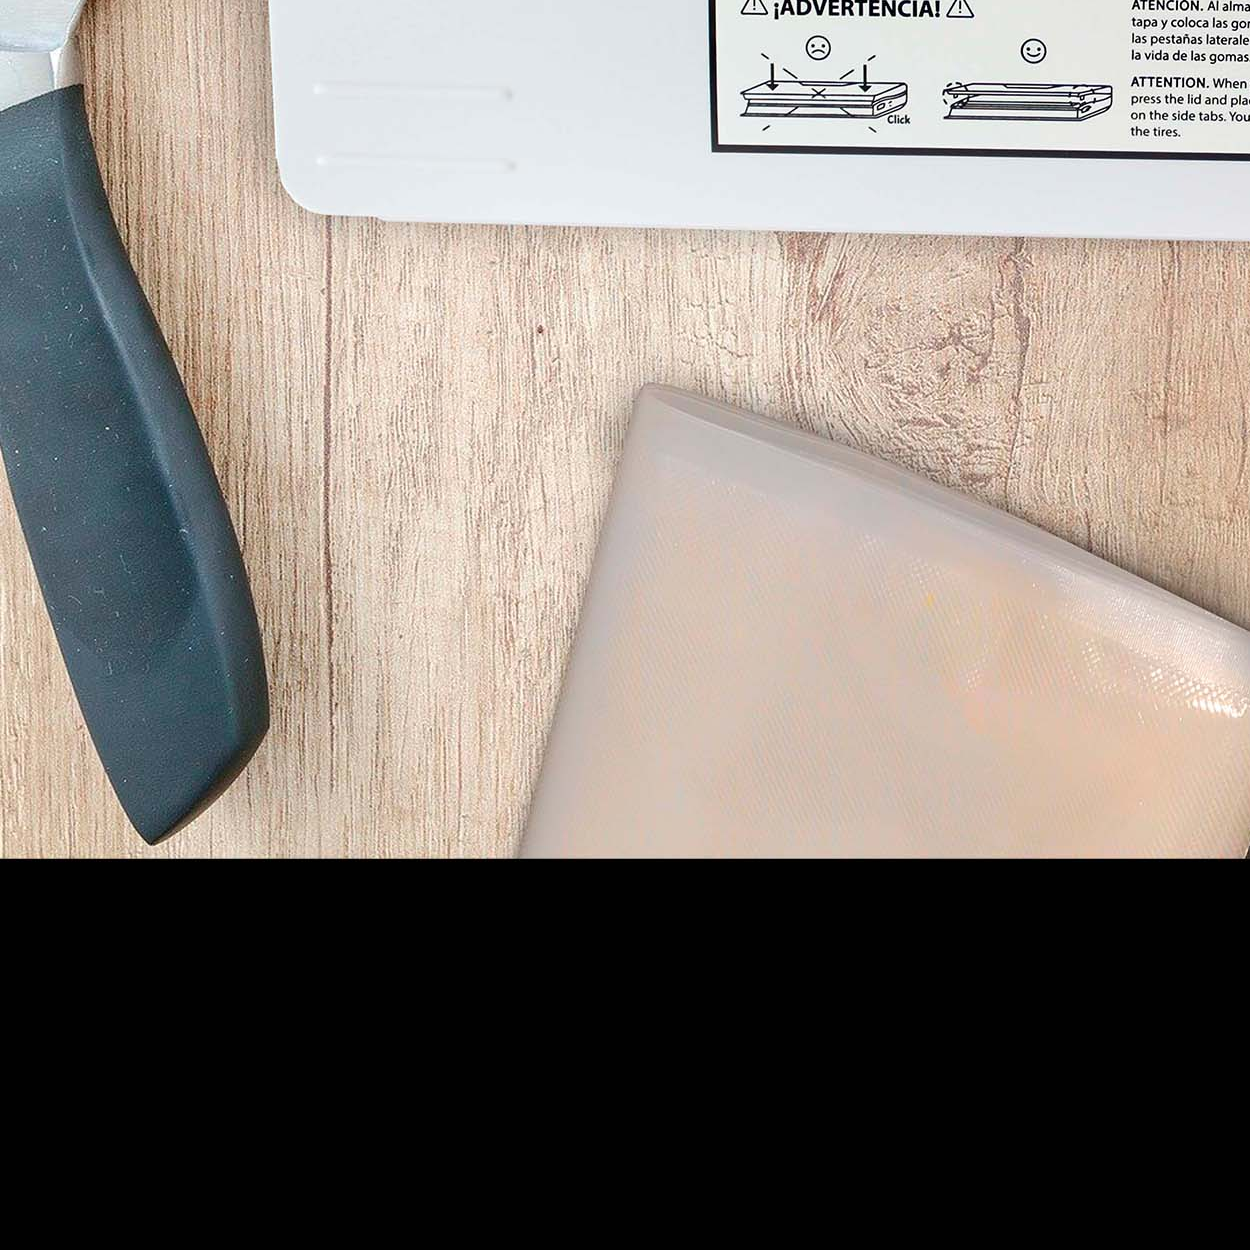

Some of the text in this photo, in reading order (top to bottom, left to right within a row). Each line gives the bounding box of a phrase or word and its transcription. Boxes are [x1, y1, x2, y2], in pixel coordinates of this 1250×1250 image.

[1207, 0, 1219, 11] Al
[1132, 17, 1158, 29] tapa
[1161, 20, 1168, 30] y
[1171, 17, 1209, 28] coloca
[1213, 17, 1228, 29] las
[1132, 33, 1147, 44] las
[1151, 34, 1203, 46] pestañas
[1132, 49, 1141, 60] la
[1144, 50, 1169, 61] vida
[1172, 50, 1188, 61] de
[1191, 50, 1206, 62] las
[1131, 76, 1209, 89] ATTENTION.
[1213, 78, 1247, 89] When
[1131, 96, 1161, 106] press
[1165, 93, 1184, 105] the
[1188, 94, 1202, 105] lid
[1205, 94, 1227, 105] and
[887, 112, 911, 125] Click
[1131, 112, 1146, 120] on
[1149, 110, 1169, 121] the
[1172, 110, 1196, 121] side
[1199, 111, 1226, 122] tabs.
[1229, 111, 1250, 122] You
[1131, 126, 1181, 137] the tires.
